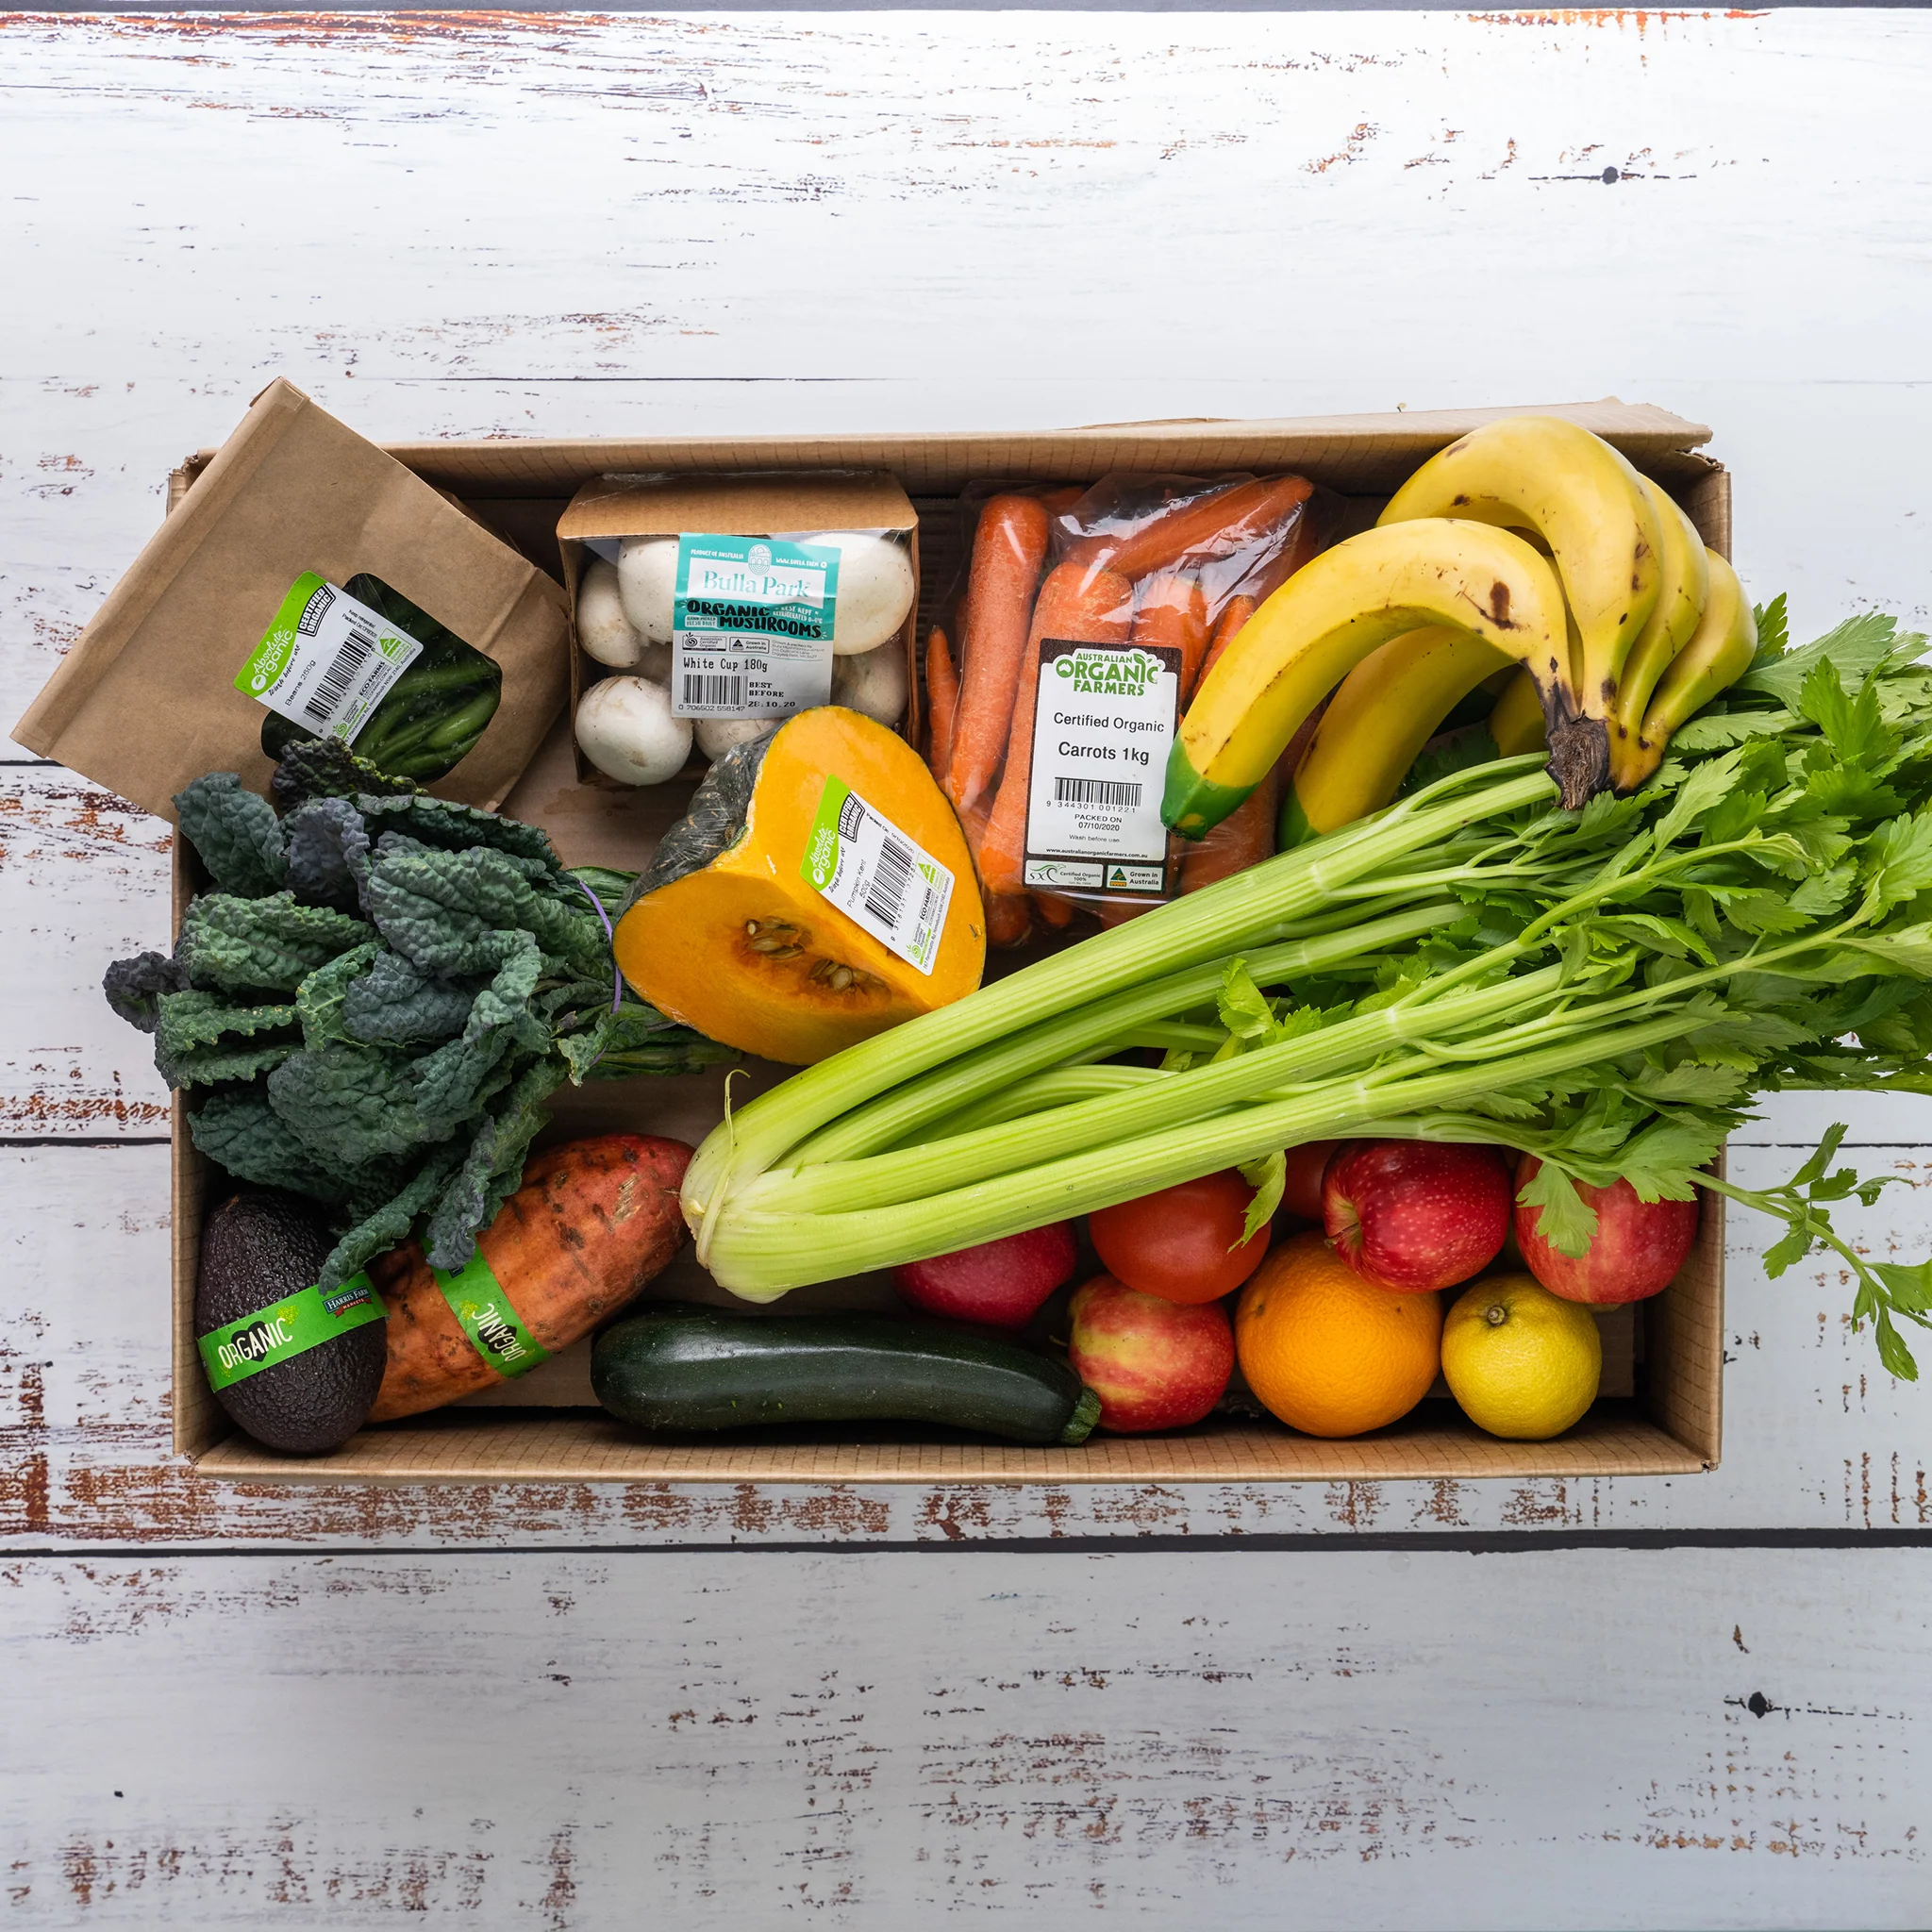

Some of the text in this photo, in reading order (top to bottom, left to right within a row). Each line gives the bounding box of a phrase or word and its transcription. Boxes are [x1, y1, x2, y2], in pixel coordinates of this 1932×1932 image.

[704, 571, 808, 598] Bulla Park
[299, 587, 325, 629] CERTIFIED
[307, 593, 331, 632] ORGANIC
[687, 600, 770, 616] ORGANIC
[720, 617, 821, 638] MUSHROOMS
[250, 630, 294, 690] Organic
[251, 625, 287, 675] Absolute
[1076, 653, 1132, 663] AUSTRALIAN
[267, 678, 284, 696] Wash
[283, 658, 295, 677] before
[683, 658, 768, 673] White Cup 180g
[1056, 657, 1158, 684] ORGANIC
[285, 659, 317, 706] Beans 250g
[1074, 680, 1144, 696] FARMERS
[1054, 712, 1164, 733] Certified Organic
[1058, 741, 1149, 765] Carrots 1kg
[839, 796, 854, 832] CERTIFIED
[1058, 801, 1094, 809] 344301
[847, 804, 861, 837] ORGANIC
[1078, 822, 1120, 831] 07/10/2020
[809, 827, 829, 867] Absolute
[813, 829, 836, 884] Organic
[1046, 848, 1147, 858] www.australianorganicfarmers.com.au
[846, 858, 867, 908] Pumpkin Kent
[859, 879, 871, 898] 500g
[327, 1293, 353, 1309] HARRIS
[343, 1298, 364, 1309] MARKETS
[218, 1318, 292, 1369] ORGANIC
[472, 1303, 526, 1362] ORGANIC
